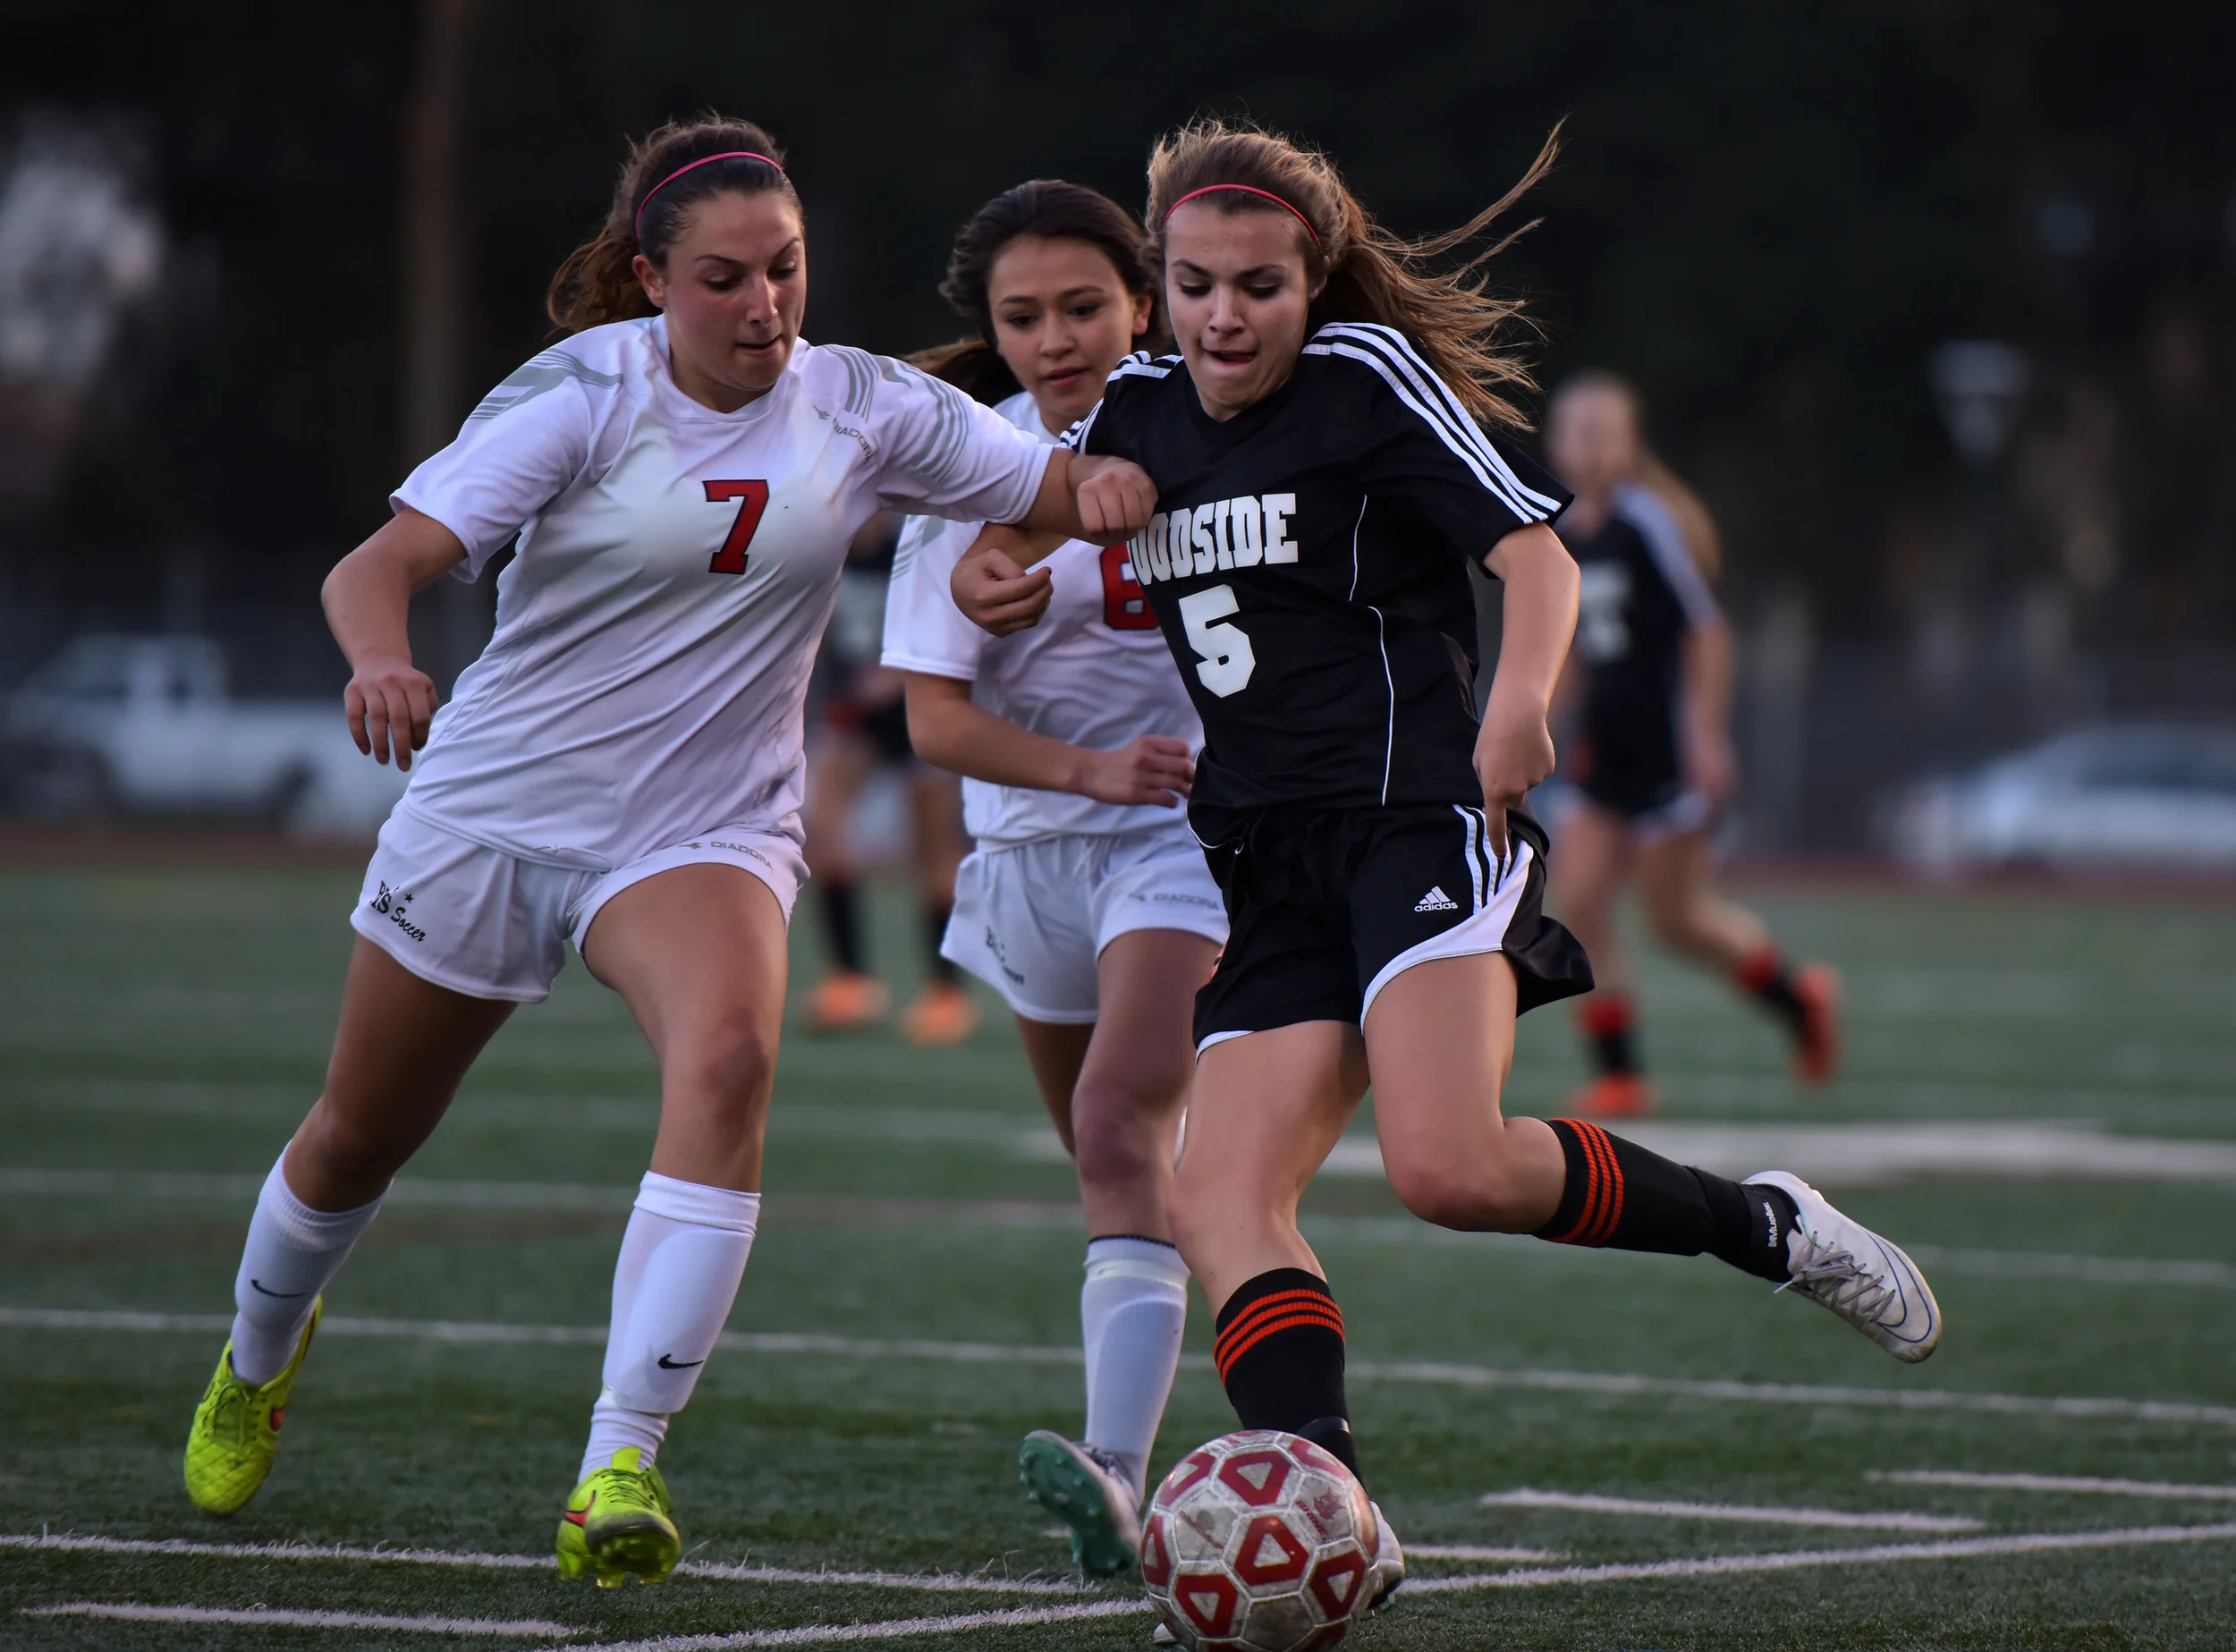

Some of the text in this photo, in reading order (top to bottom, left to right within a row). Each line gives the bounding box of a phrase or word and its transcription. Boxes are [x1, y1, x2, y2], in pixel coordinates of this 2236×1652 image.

[701, 479, 770, 575] 7
[1127, 493, 1299, 586] OODSIDE
[1178, 583, 1257, 699] 5
[710, 841, 774, 870] DIADORA
[390, 906, 427, 942] Soccer
[1414, 901, 1459, 911] adidas
